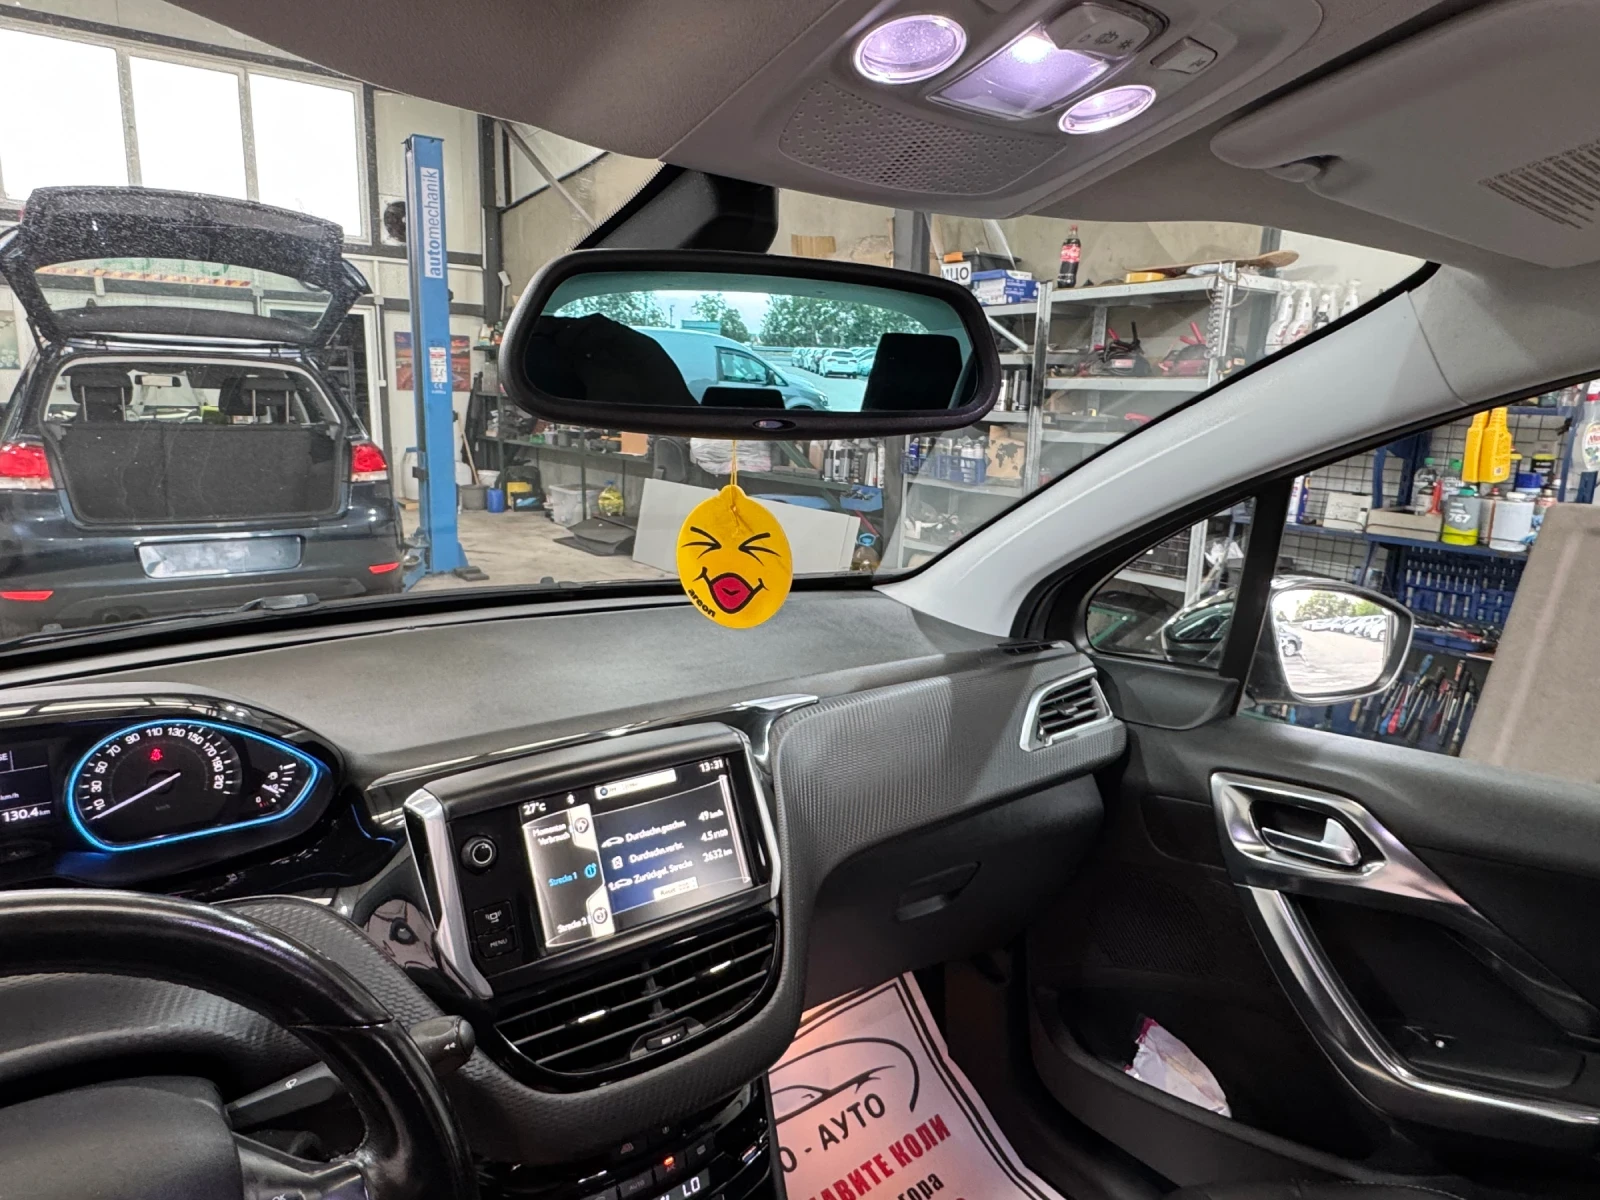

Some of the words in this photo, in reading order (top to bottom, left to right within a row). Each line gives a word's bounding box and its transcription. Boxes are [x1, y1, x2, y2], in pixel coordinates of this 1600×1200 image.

[424, 170, 442, 277] automechanik
[1449, 513, 1471, 524] 767
[688, 589, 716, 618] areon
[125, 732, 140, 745] 90
[145, 727, 163, 737] 110
[167, 727, 186, 738] 130
[187, 731, 204, 745] 150
[106, 744, 121, 757] 70
[202, 742, 217, 757] 170
[94, 761, 108, 774] 50
[211, 756, 224, 773] 190
[699, 760, 723, 773] 13:31
[90, 780, 102, 793] 30
[213, 774, 225, 790] 210
[93, 798, 105, 811] 10
[2, 807, 38, 822] 130.4
[698, 810, 709, 821] 49
[489, 938, 508, 948] MENU
[818, 1093, 886, 1151] АУТО
[888, 1113, 951, 1168] КОЛИ
[629, 1180, 646, 1191] AUTO
